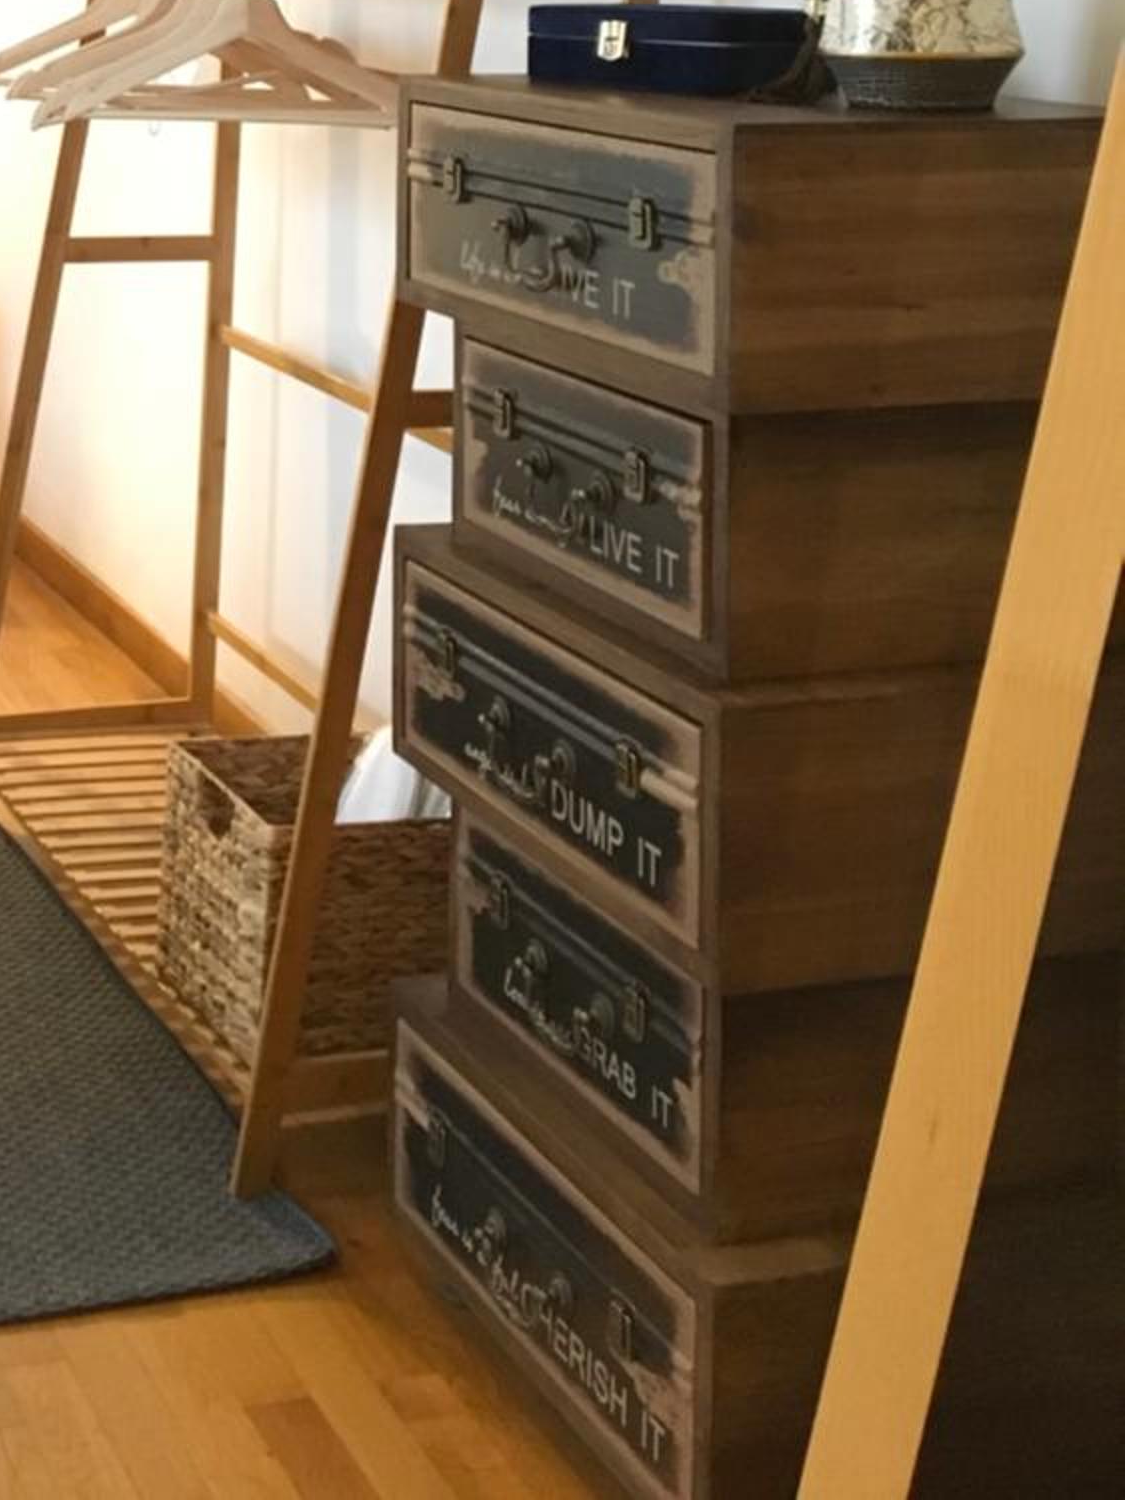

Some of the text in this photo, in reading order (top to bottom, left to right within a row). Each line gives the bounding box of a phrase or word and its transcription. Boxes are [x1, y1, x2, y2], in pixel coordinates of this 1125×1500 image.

[612, 276, 636, 321] IT
[589, 514, 679, 589] LIVE IT
[551, 780, 662, 887] DUMP IT
[578, 1025, 673, 1128] GRAB IT
[527, 1290, 666, 1463] HERISH IT
